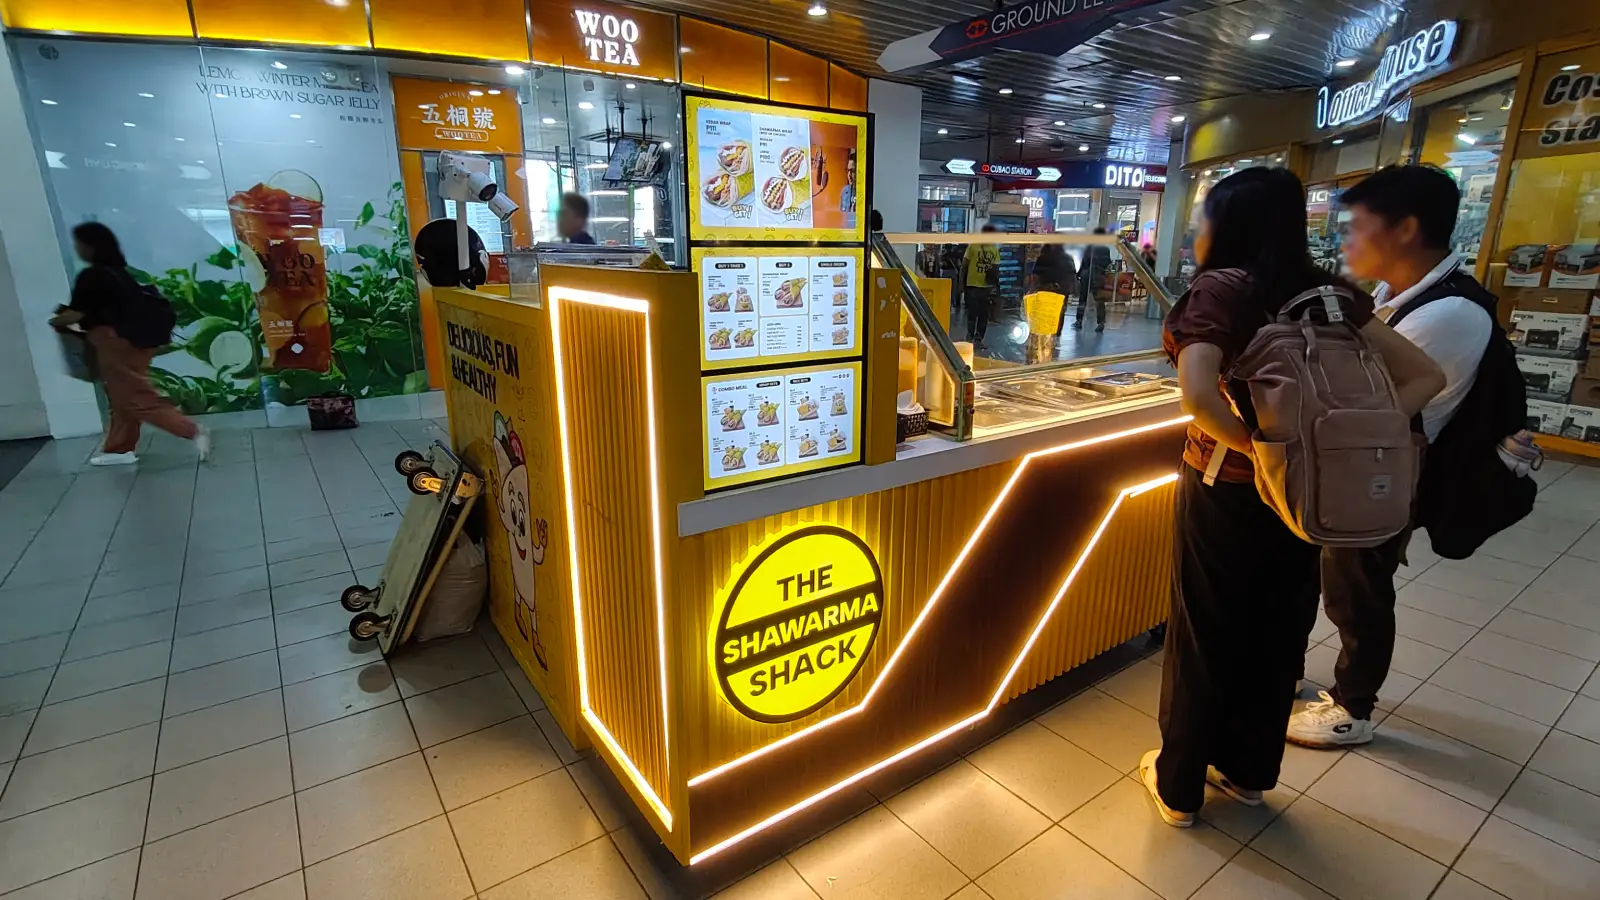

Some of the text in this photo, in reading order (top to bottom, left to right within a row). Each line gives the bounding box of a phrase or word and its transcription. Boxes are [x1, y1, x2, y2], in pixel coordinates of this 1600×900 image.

[575, 9, 639, 43] WOO
[991, 0, 1075, 34] GROUND
[584, 36, 640, 66] TEA
[196, 82, 381, 110] WITH BROWN SUGAR JELLY
[258, 72, 310, 88] WINTER
[357, 81, 379, 94] EA
[421, 103, 497, 130] 五桐號
[442, 130, 482, 140] WOOTEA
[990, 164, 1011, 174] CUBAO
[1011, 167, 1033, 176] STATION
[1105, 165, 1142, 187] DITO
[494, 339, 520, 380] FUN
[777, 564, 833, 601] THE
[723, 592, 878, 664] SHAWARMA
[750, 635, 857, 697] SHACK
